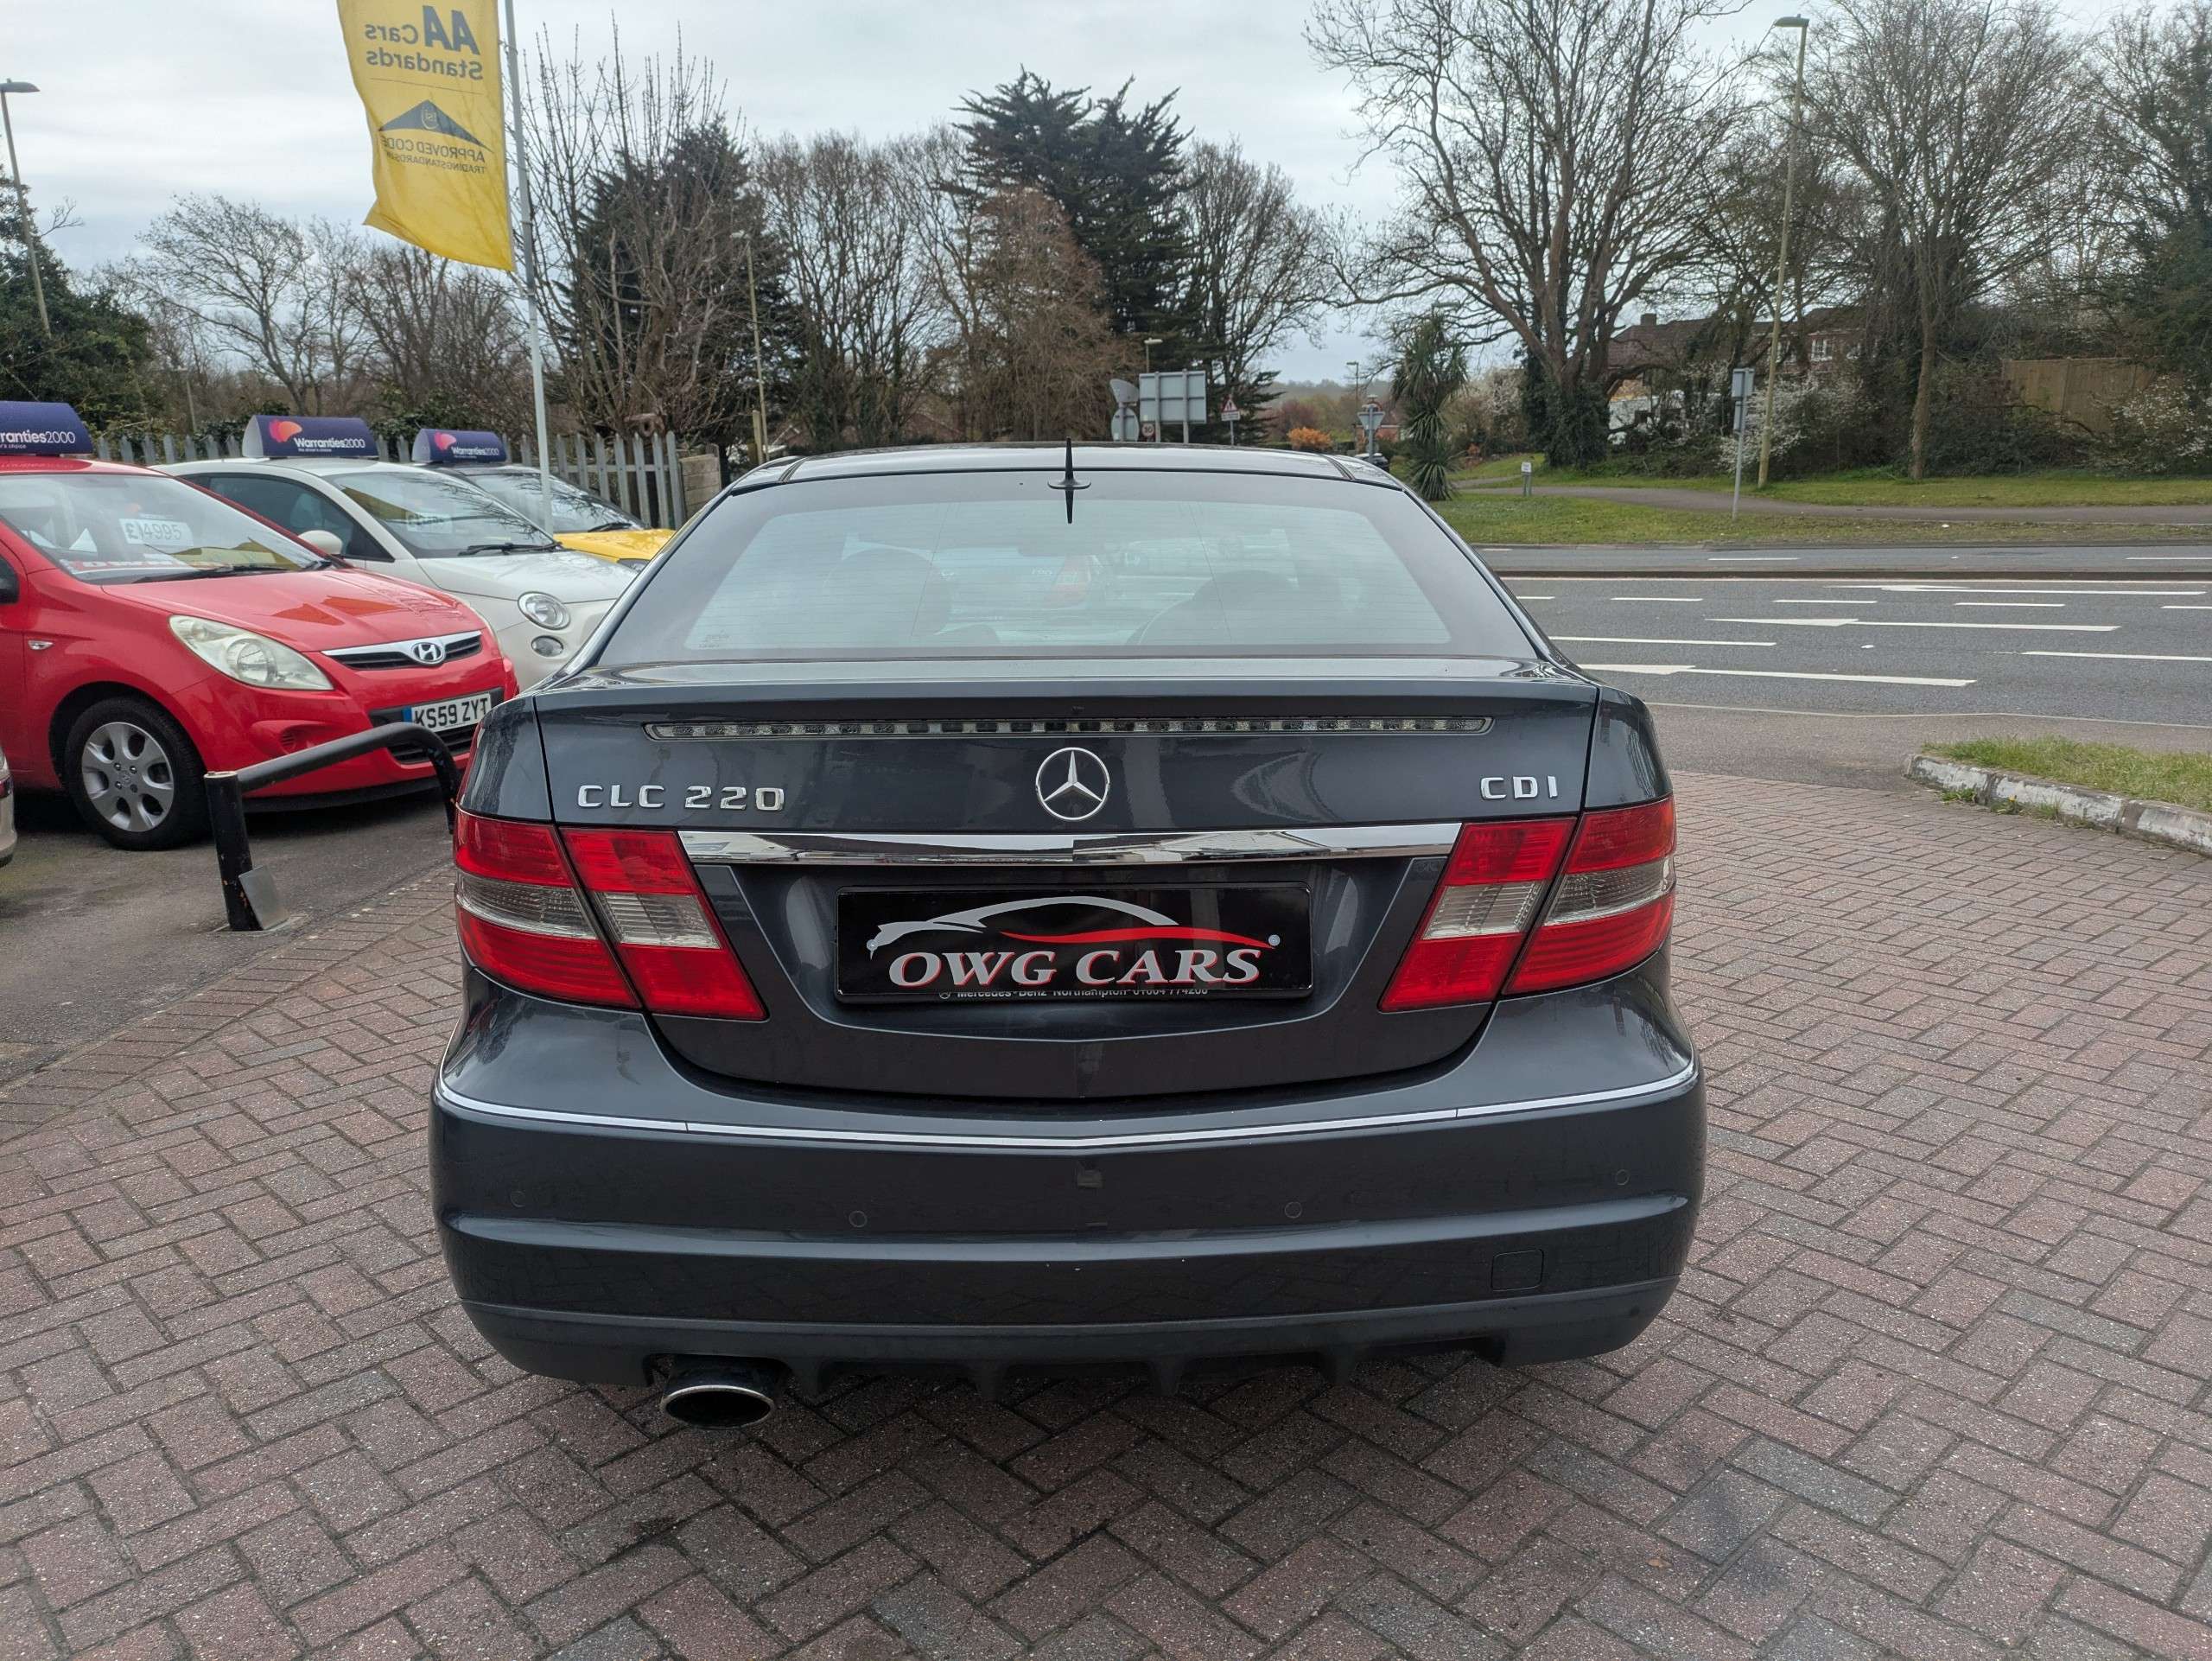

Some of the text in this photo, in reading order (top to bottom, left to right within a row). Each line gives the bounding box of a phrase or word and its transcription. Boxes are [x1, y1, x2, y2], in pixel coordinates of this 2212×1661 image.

[294, 436, 365, 449] Warranties2000
[415, 697, 488, 729] KS59 ZYT
[576, 784, 785, 811] CLC 220
[1480, 775, 1559, 799] CDI
[888, 949, 1262, 987] OWG CARS
